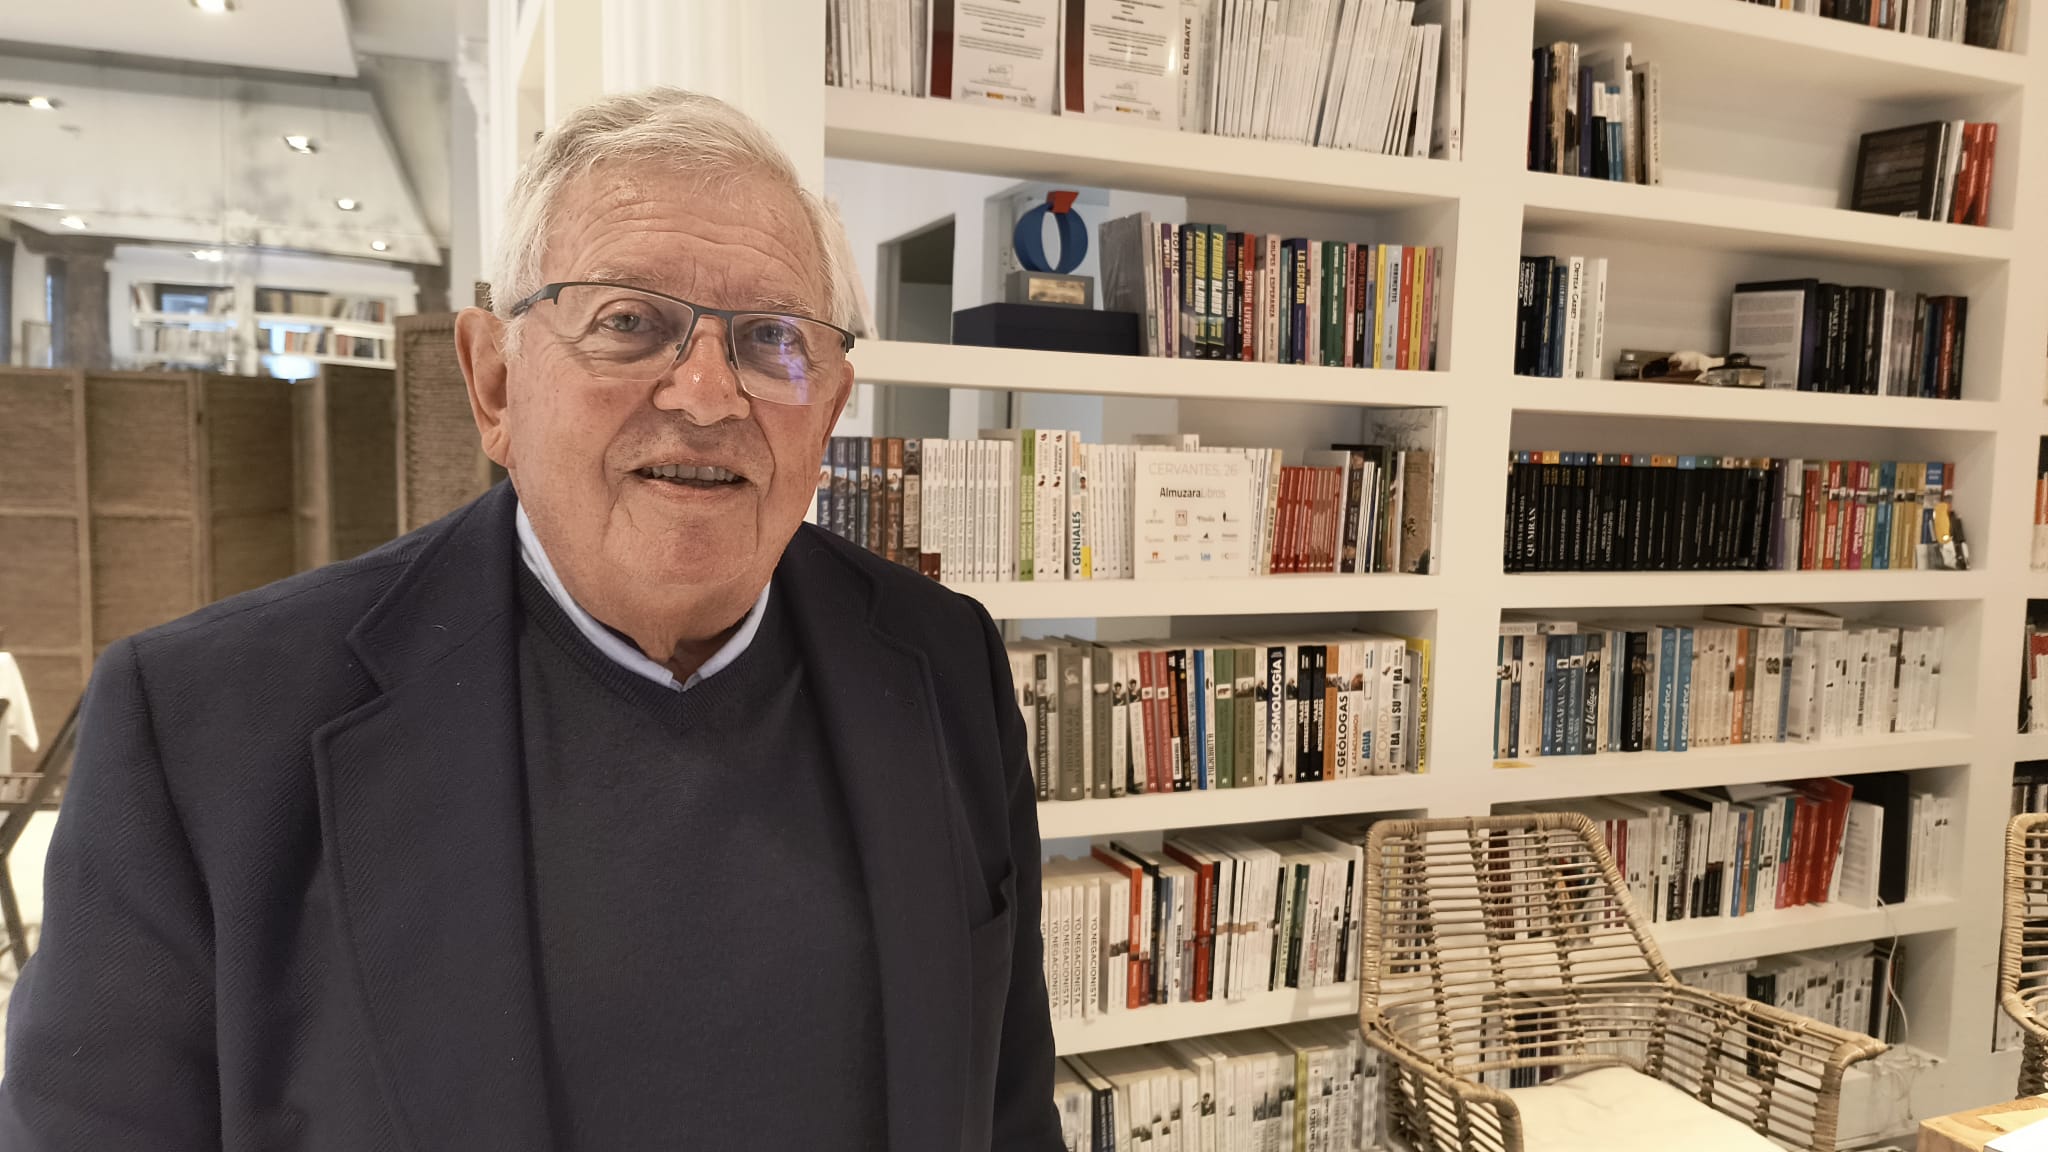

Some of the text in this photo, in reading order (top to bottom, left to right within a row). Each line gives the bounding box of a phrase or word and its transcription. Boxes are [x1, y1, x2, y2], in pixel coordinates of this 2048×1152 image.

[1182, 17, 1192, 76] EL DEBATE
[1195, 231, 1205, 314] FERNANDO ALONSO
[1212, 233, 1223, 315] FERNANDO ALONSO
[1296, 250, 1305, 304] LA ESCAPADA
[1358, 251, 1366, 274] DORI
[1243, 307, 1251, 348] LIVERPOOL
[1072, 511, 1081, 566] GENIALES
[1337, 695, 1347, 767] GEÓLOGAS
[1376, 704, 1389, 761] COMIDA
[1391, 668, 1402, 745] BA SU RA
[1555, 677, 1566, 743] MEGAFAUNA
[1362, 731, 1371, 759] AGUA
[1073, 933, 1081, 1004] NEGACIONISTA
